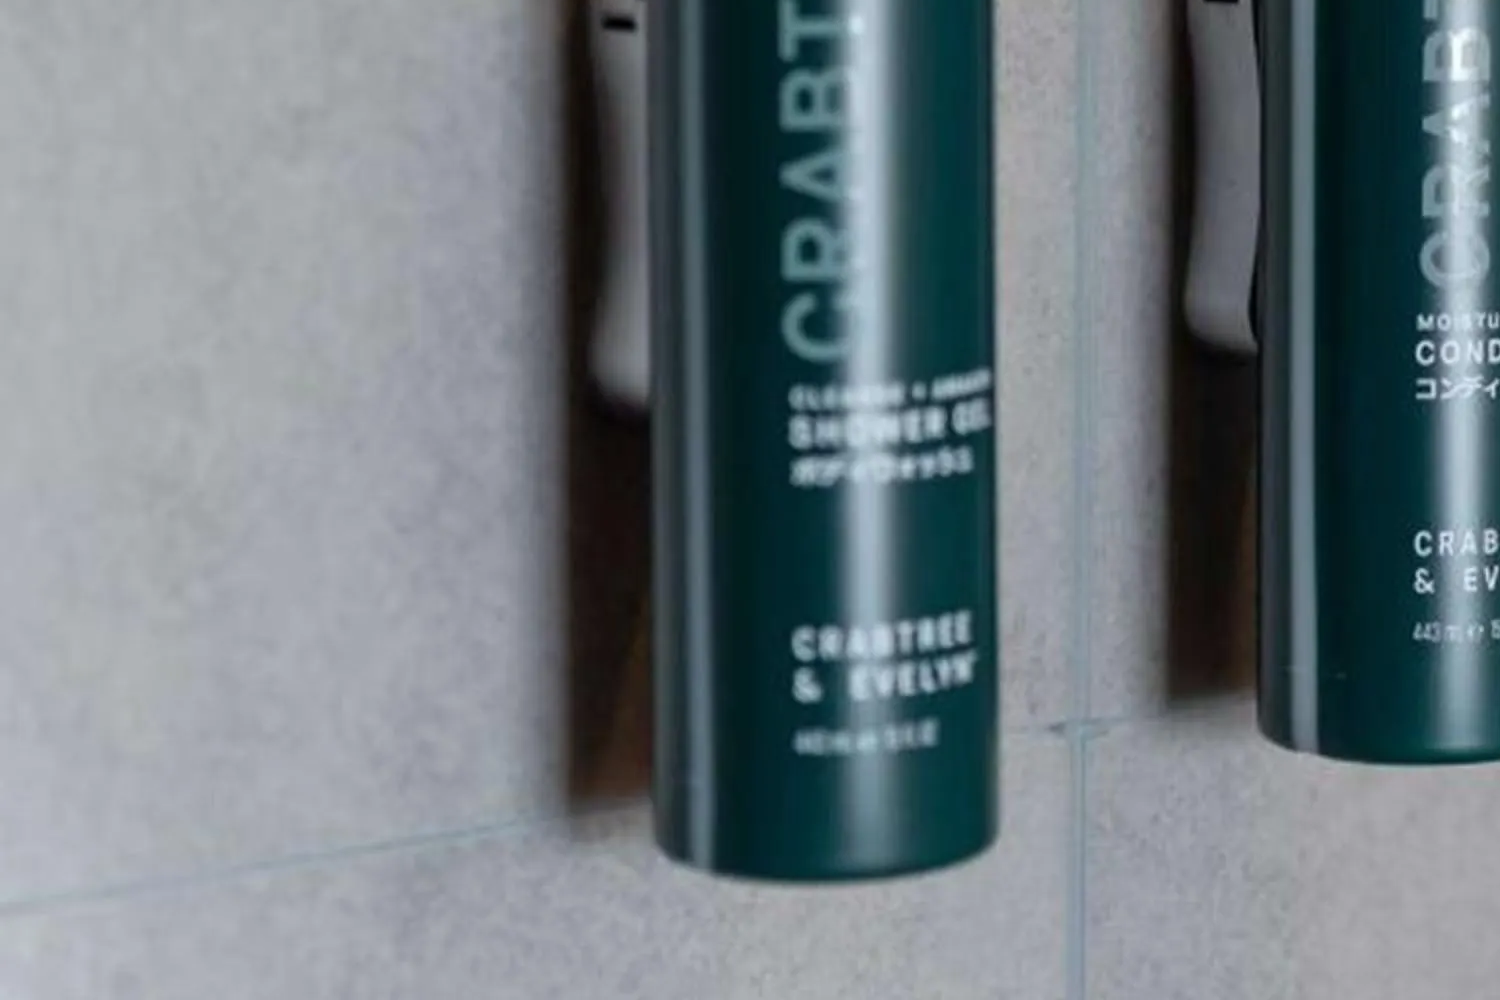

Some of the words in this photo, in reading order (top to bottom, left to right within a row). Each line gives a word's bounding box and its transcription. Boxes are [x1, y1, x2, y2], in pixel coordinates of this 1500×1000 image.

[788, 406, 947, 450] SHOWER
[1413, 567, 1435, 595] &
[791, 609, 972, 662] CRABTREE
[792, 666, 823, 704] &
